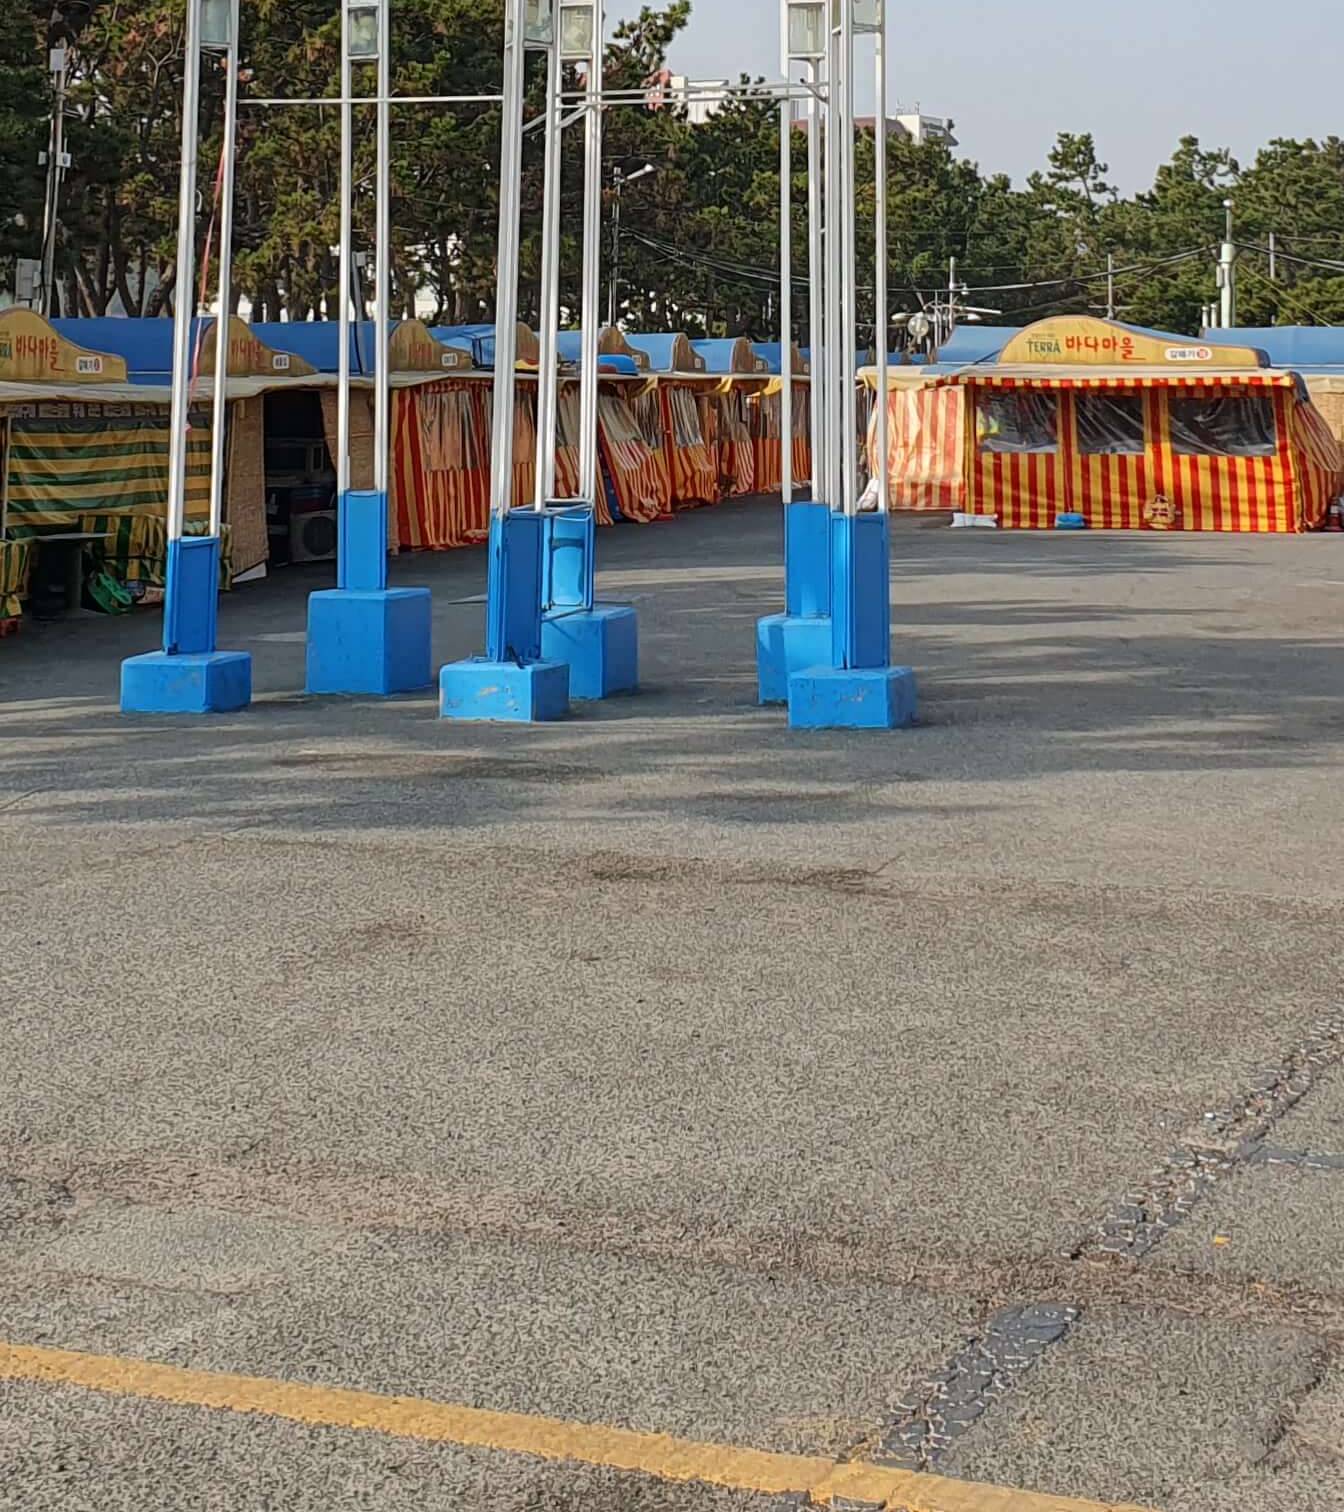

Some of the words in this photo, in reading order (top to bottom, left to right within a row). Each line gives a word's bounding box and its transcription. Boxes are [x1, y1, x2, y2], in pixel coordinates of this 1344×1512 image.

[16, 335, 64, 371] 바다마을
[1027, 340, 1061, 354] TERRA
[1065, 336, 1146, 360] 바다마을
